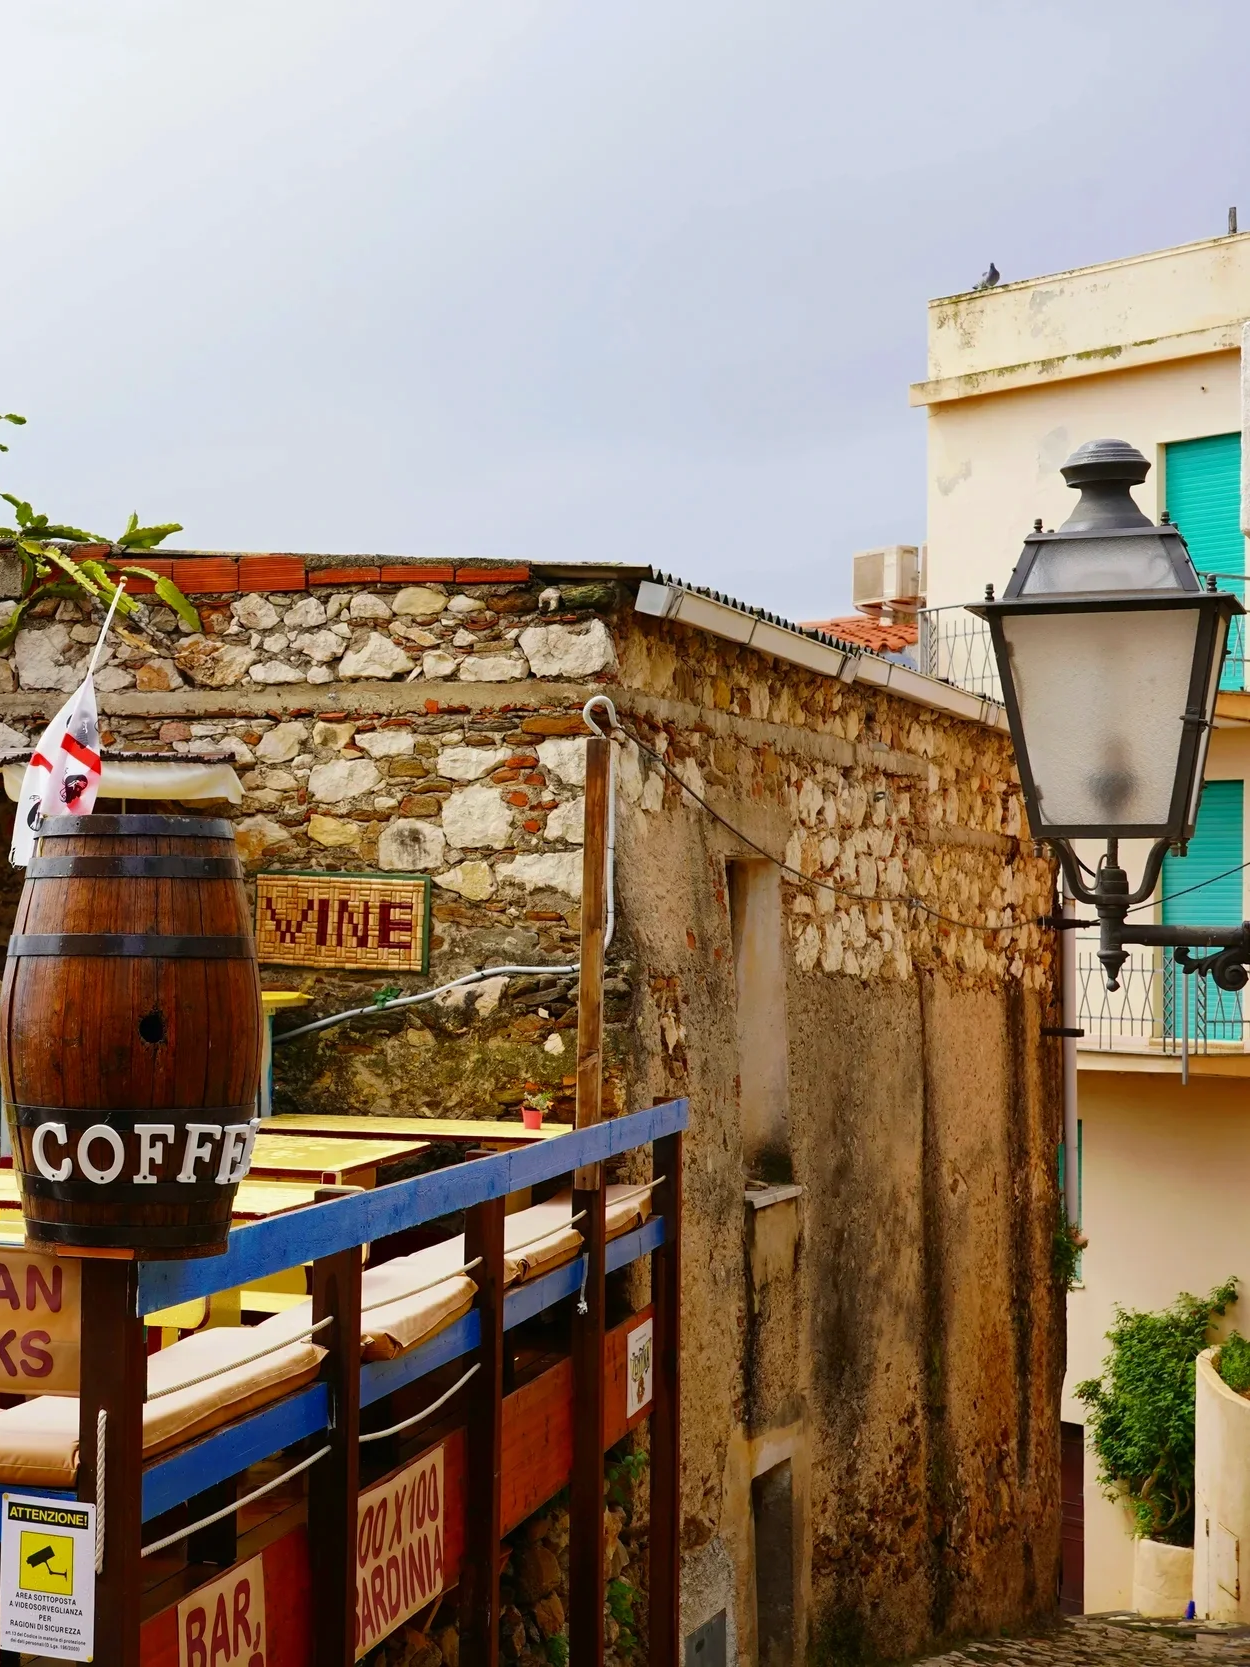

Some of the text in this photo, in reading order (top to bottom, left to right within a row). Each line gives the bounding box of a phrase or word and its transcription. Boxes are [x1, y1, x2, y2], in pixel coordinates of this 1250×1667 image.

[265, 897, 413, 949] WINE
[32, 1118, 261, 1185] COFFE
[9, 1506, 88, 1526] ATTENZIONE!
[16, 1592, 76, 1605] AREA SOTTOPOSTA
[15, 1601, 83, 1616] VIDEOSORVEGLIANZA
[39, 1614, 52, 1622] PER
[185, 1578, 261, 1667] BAR,
[10, 1620, 35, 1629] RAGIONI
[45, 1625, 81, 1635] SICUREZZA
